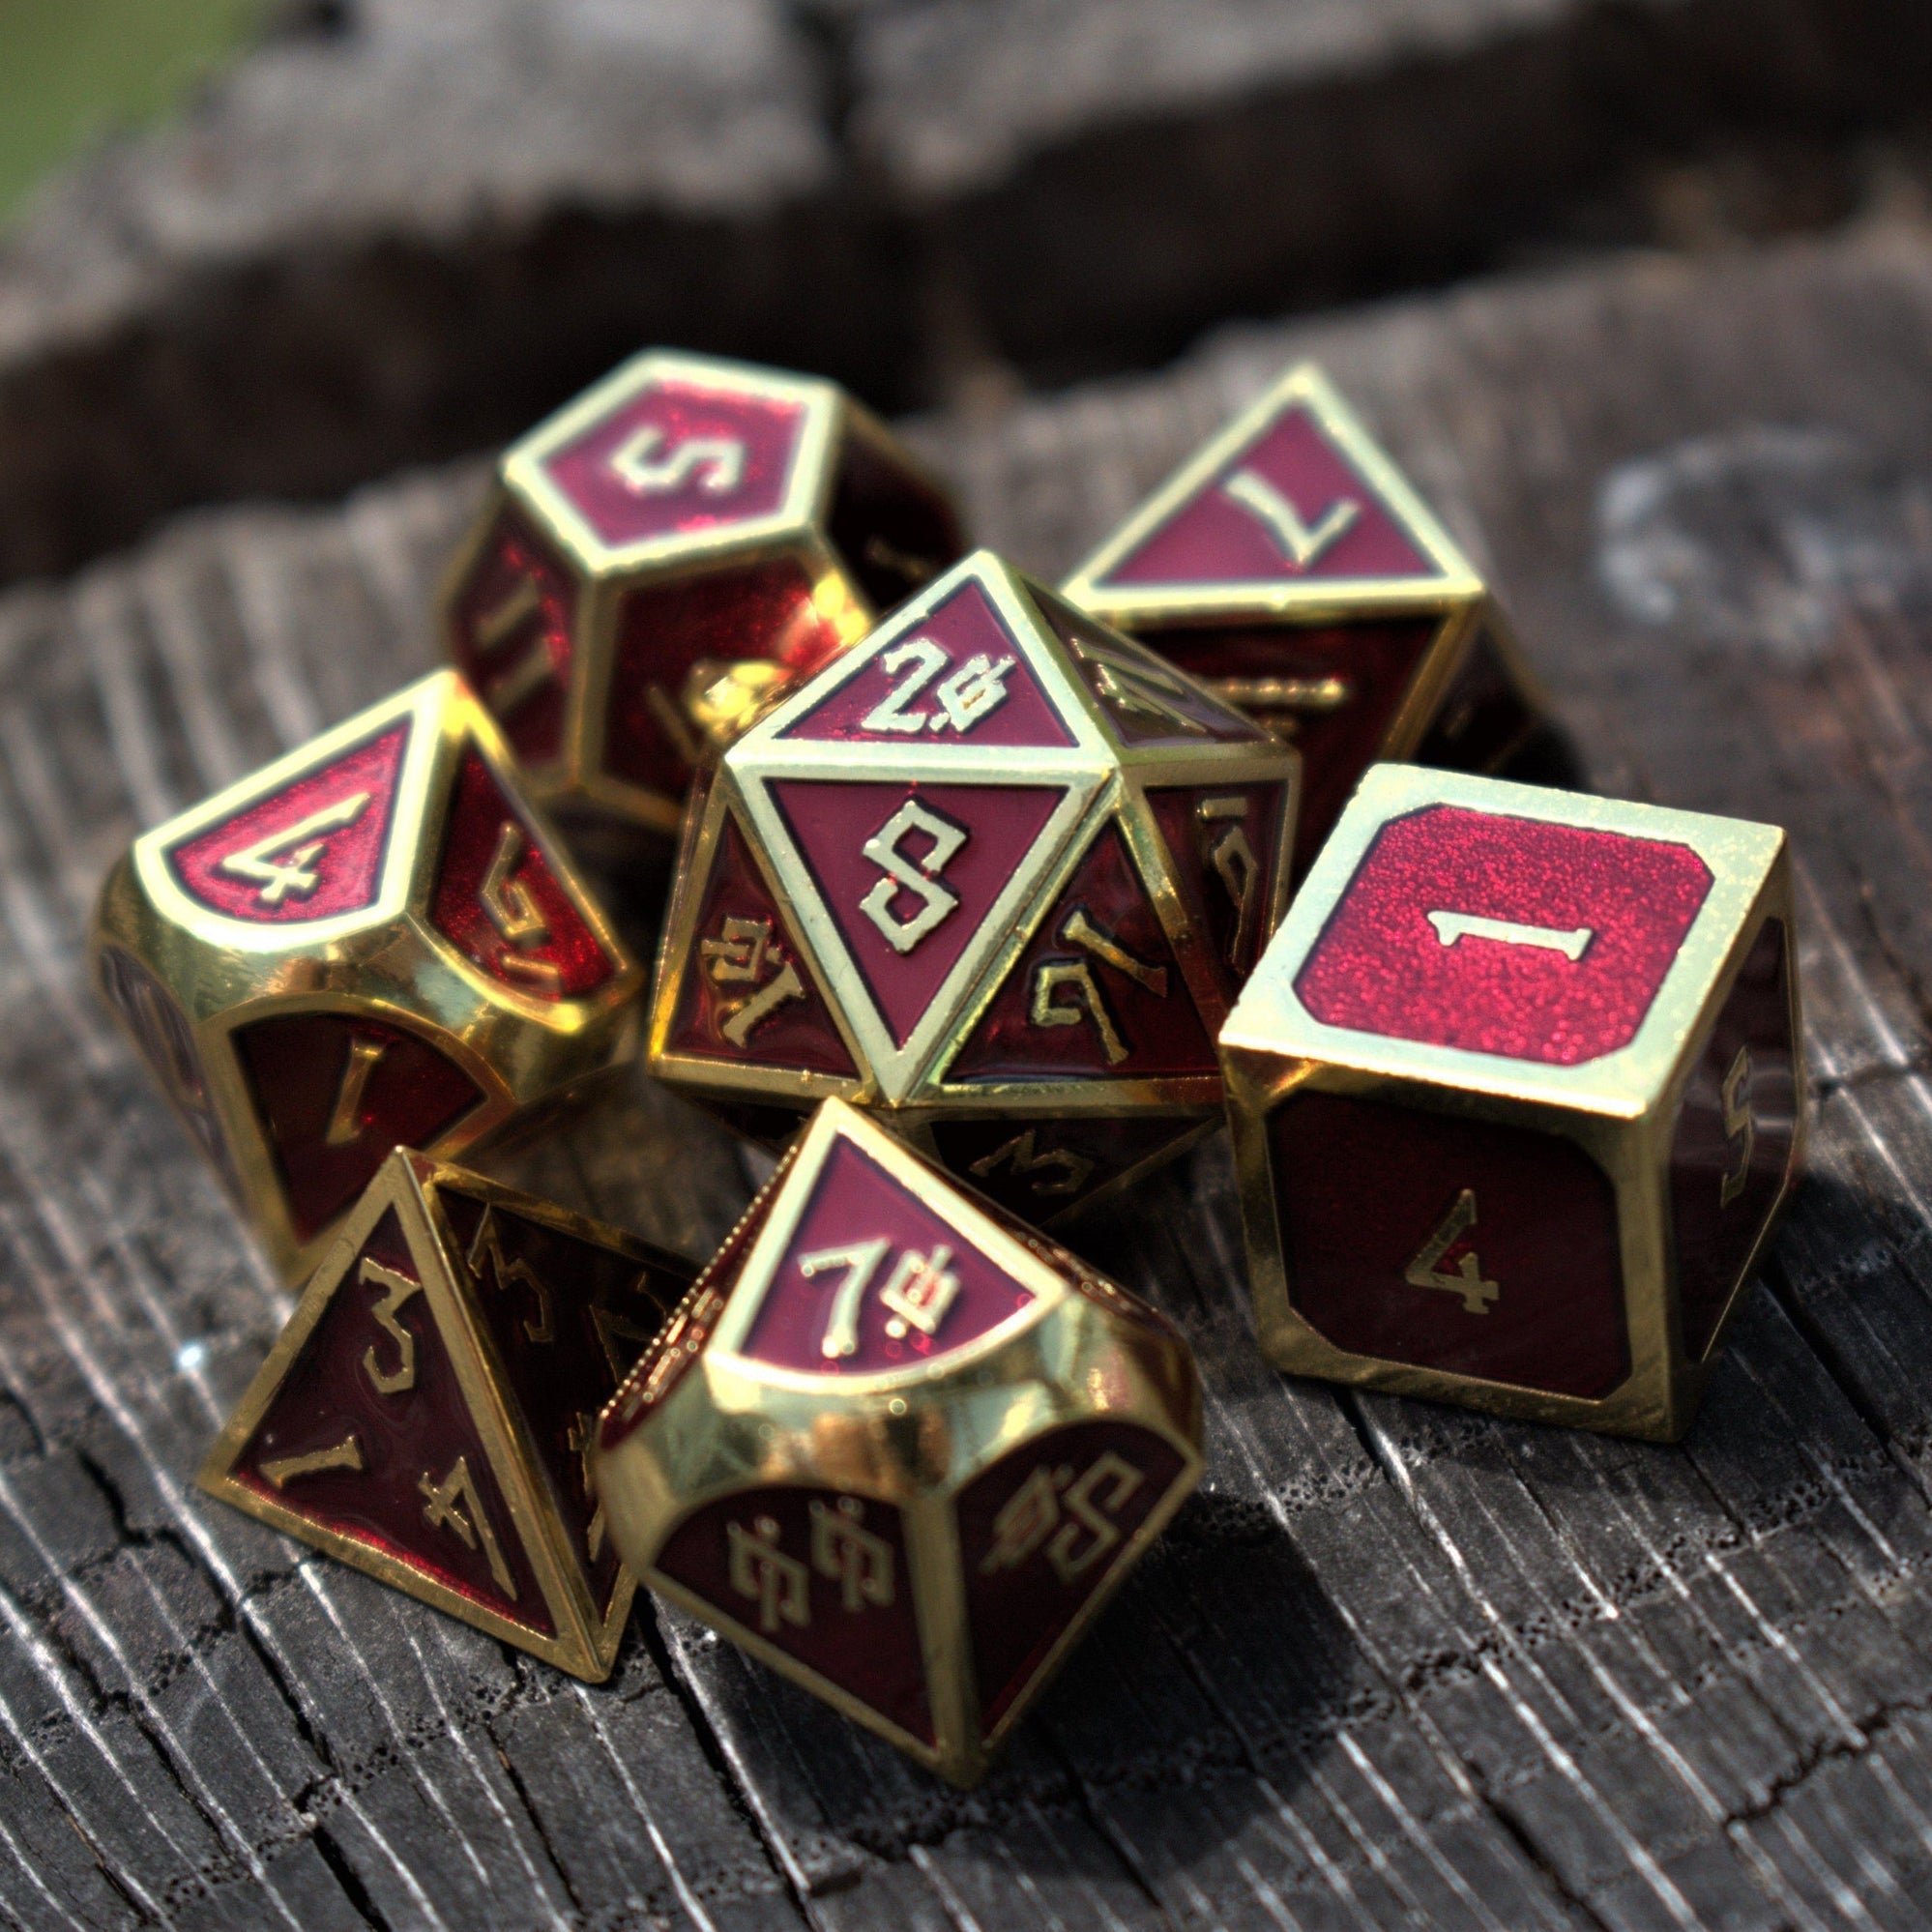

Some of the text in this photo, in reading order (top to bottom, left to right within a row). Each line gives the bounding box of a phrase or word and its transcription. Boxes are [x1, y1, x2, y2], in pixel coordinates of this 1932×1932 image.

[1224, 468, 1362, 569] 7
[221, 790, 373, 907] 4
[858, 798, 969, 955] 8
[1426, 909, 1595, 962] 1
[1404, 1186, 1501, 1316] 4
[358, 1255, 423, 1395] 3
[259, 1434, 366, 1489] 1
[417, 1455, 519, 1602] 4
